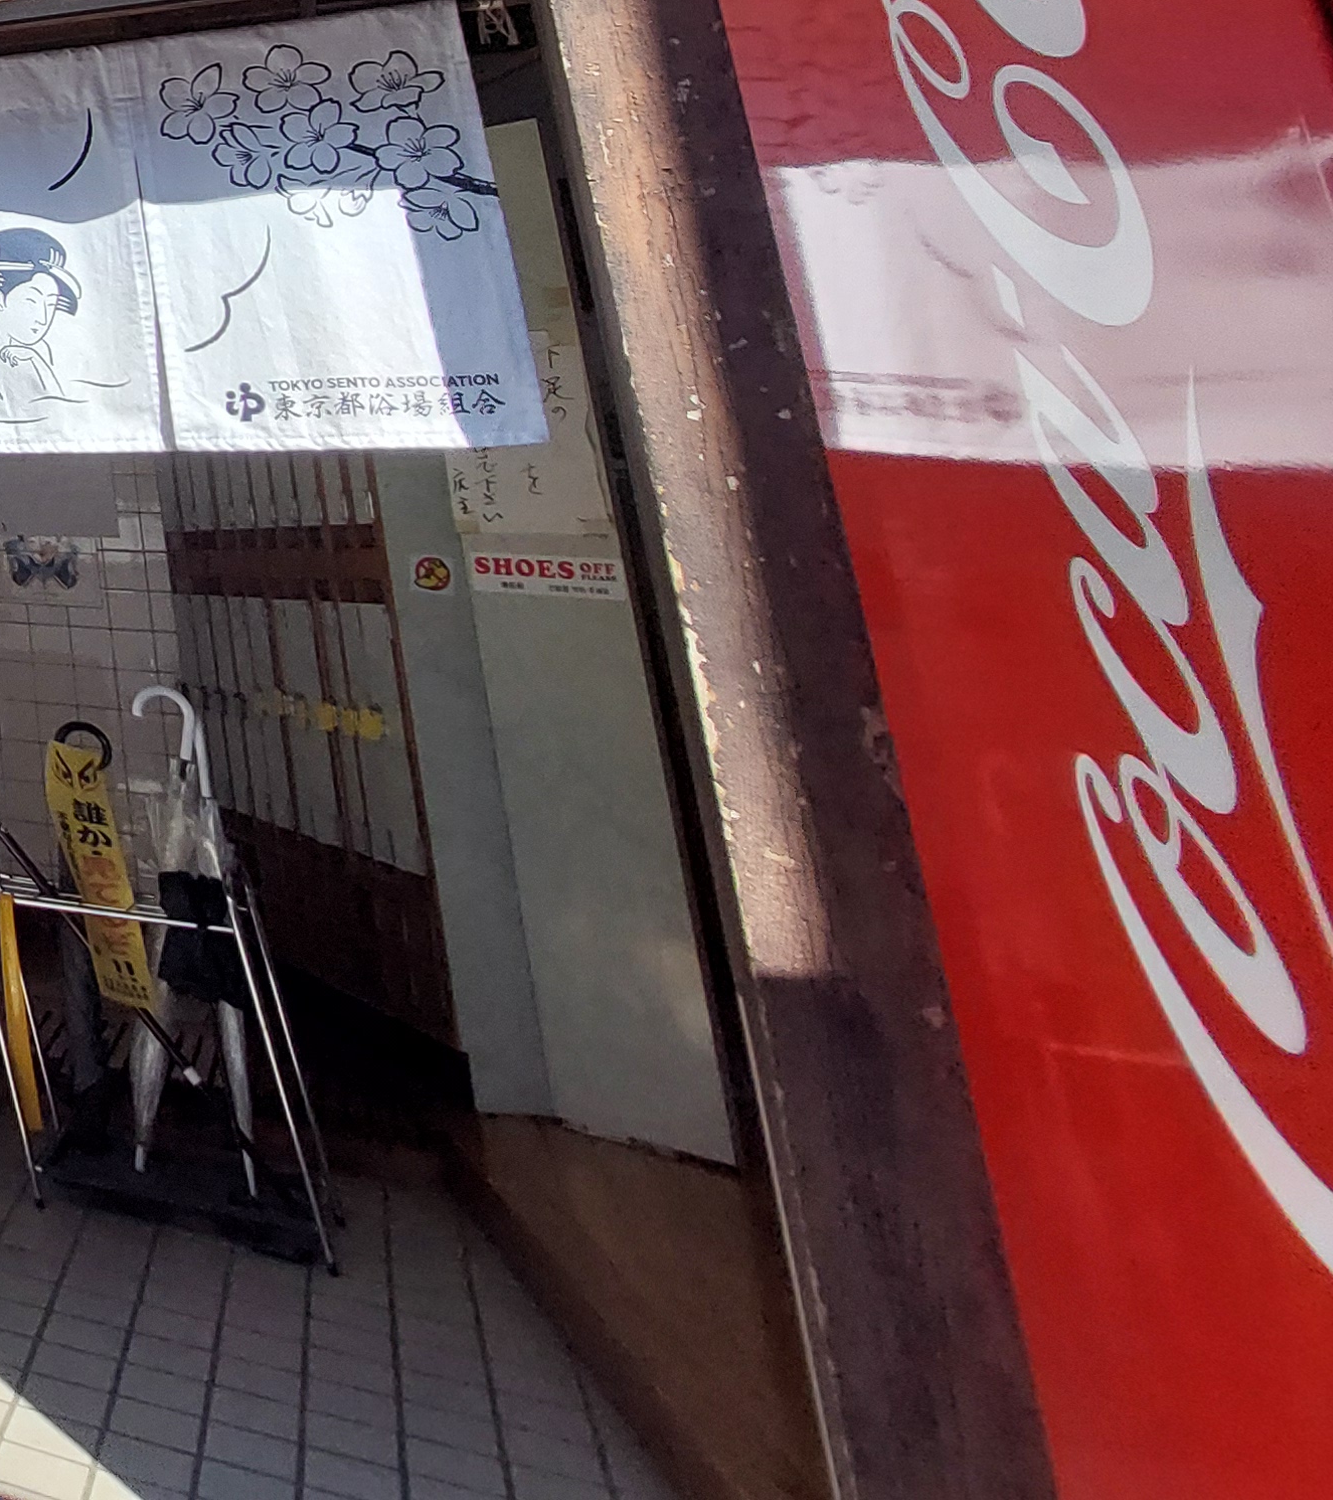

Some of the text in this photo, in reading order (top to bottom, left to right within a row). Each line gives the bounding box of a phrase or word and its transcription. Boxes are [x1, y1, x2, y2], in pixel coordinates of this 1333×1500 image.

[269, 373, 500, 392] TOKYO SENTO ASSOCIATION
[274, 389, 506, 421] 東京都浴場組合
[474, 556, 615, 579] SHOES OFF
